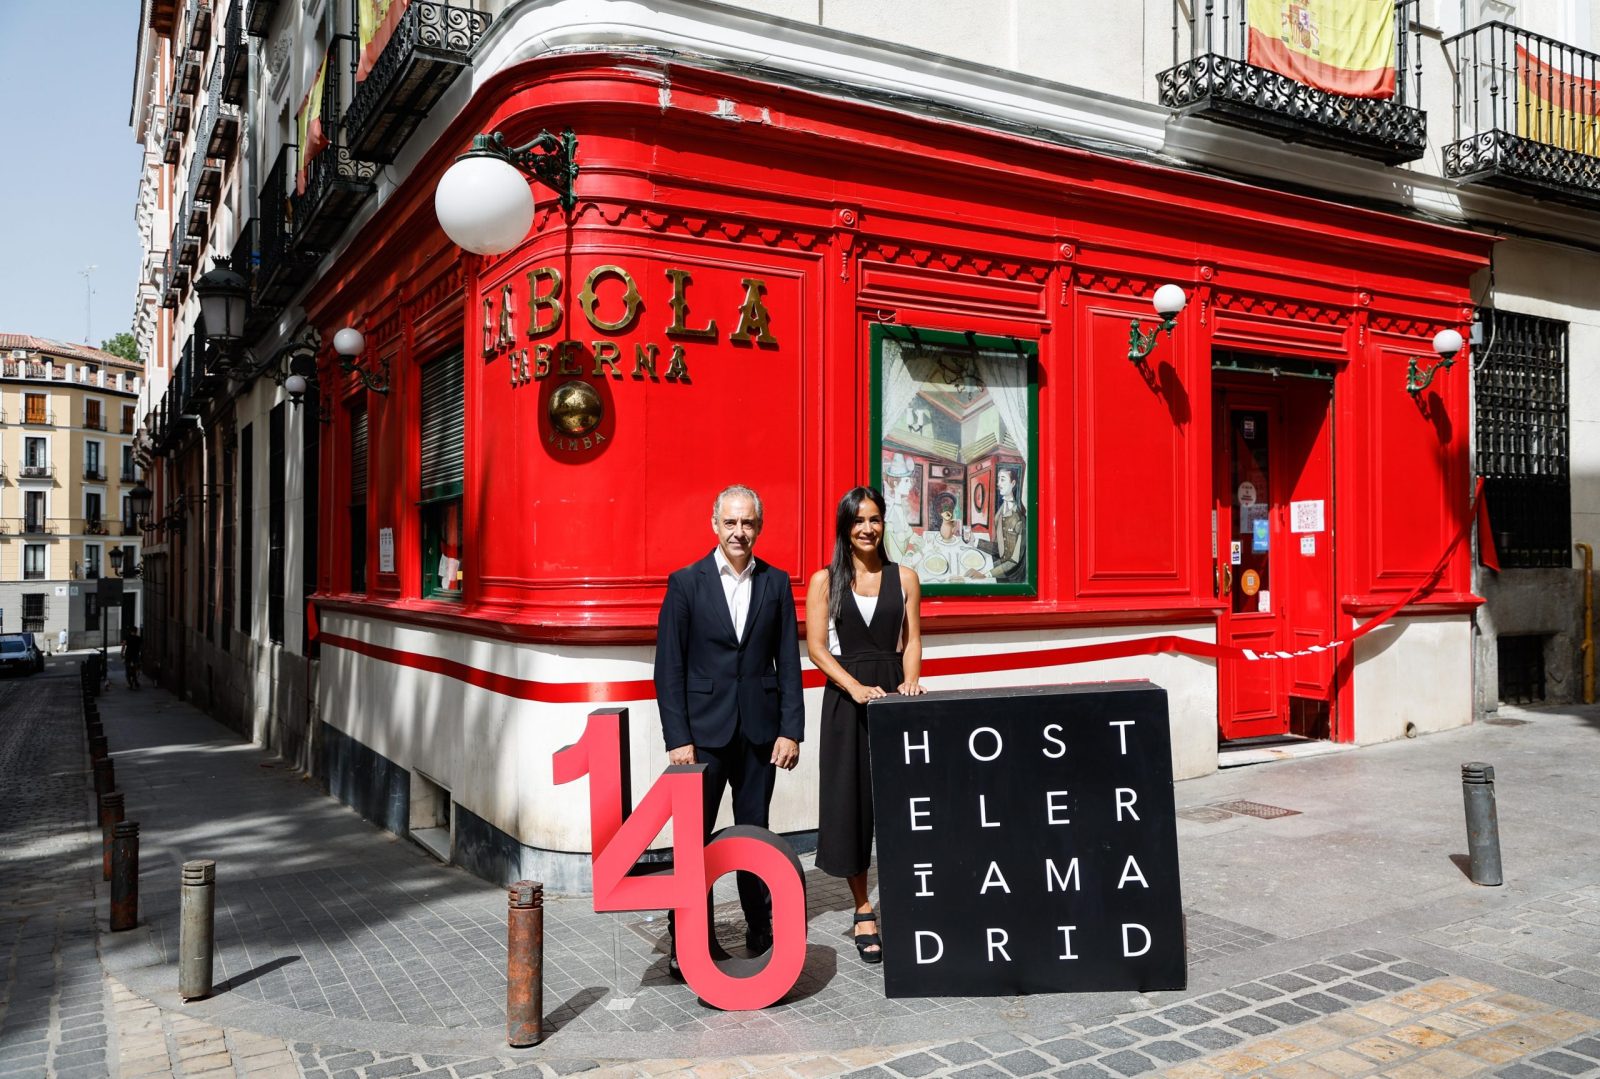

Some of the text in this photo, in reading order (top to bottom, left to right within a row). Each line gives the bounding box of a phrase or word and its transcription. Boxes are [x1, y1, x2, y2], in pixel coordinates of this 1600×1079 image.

[481, 264, 777, 358] LA BOLA
[509, 340, 690, 384] TABERNA
[552, 707, 808, 1011] 140
